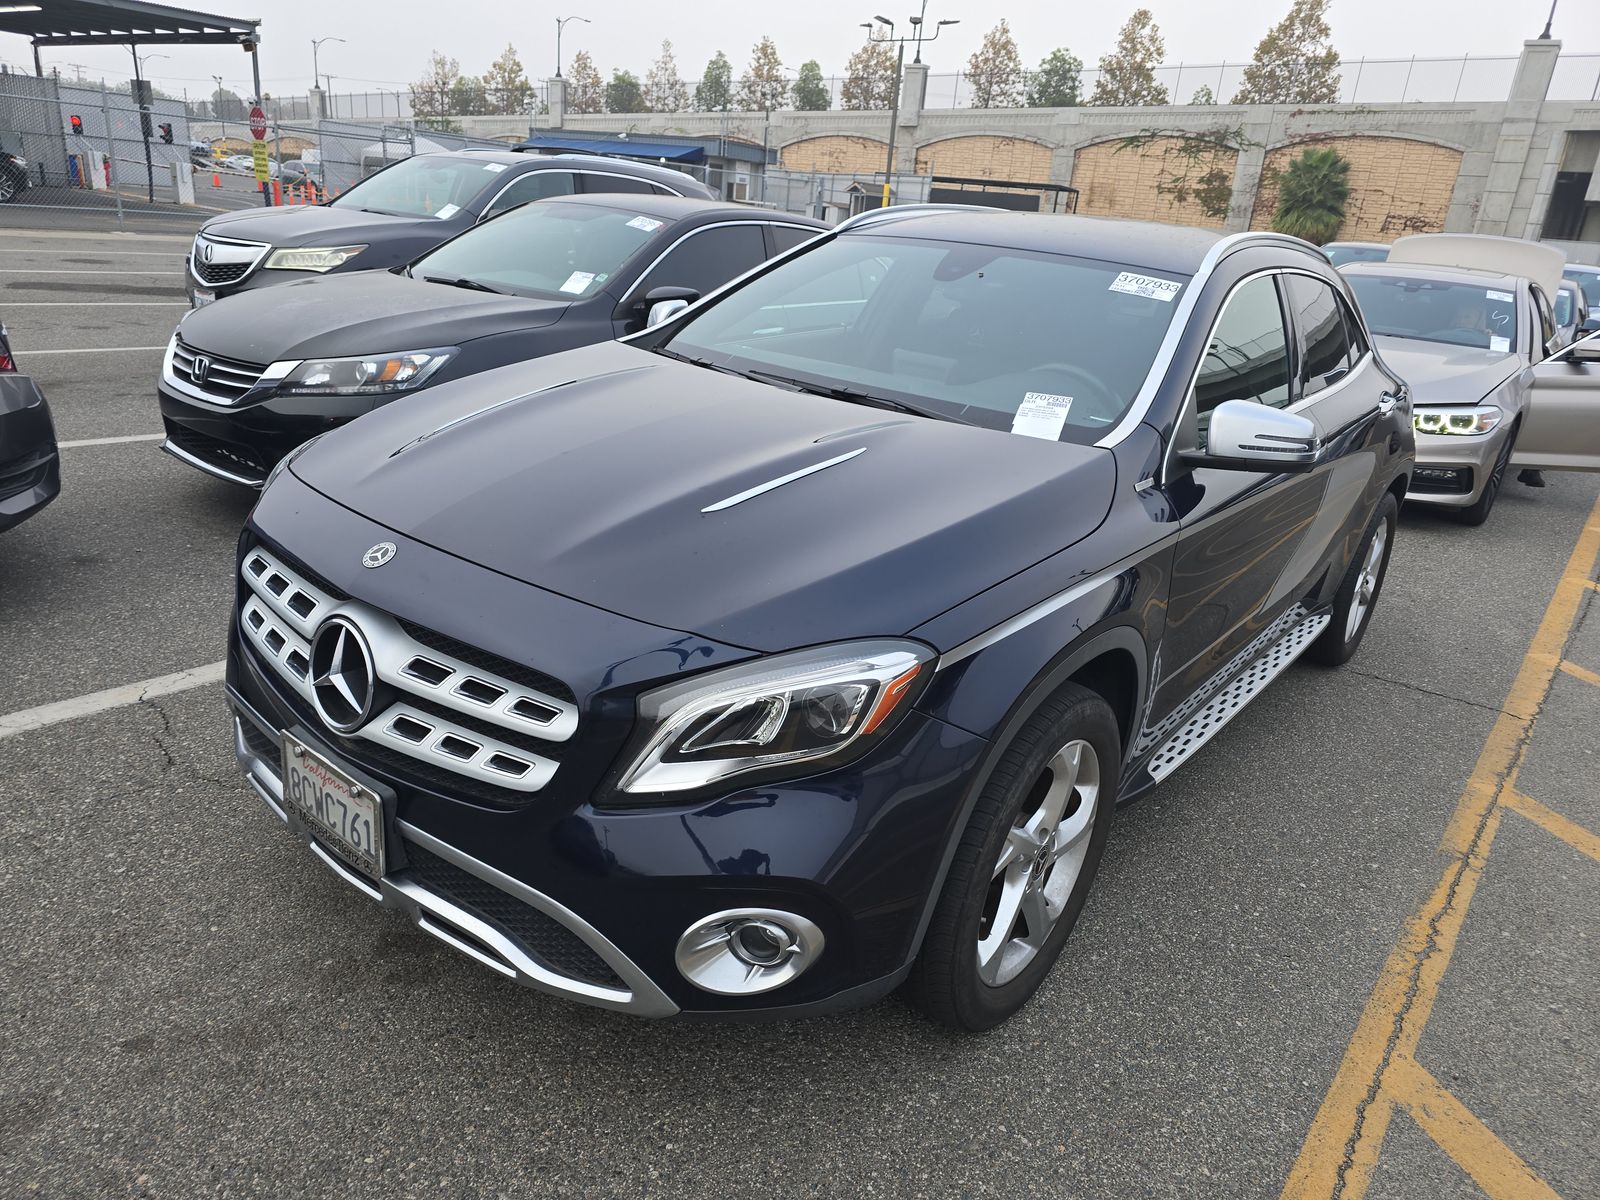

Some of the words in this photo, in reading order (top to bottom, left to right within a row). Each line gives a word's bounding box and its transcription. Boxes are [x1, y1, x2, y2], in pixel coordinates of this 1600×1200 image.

[250, 117, 266, 130] STOP
[1118, 274, 1179, 293] 3707933
[1027, 393, 1071, 404] 3707933
[302, 754, 357, 799] Californ
[291, 767, 375, 857] 8CWC761
